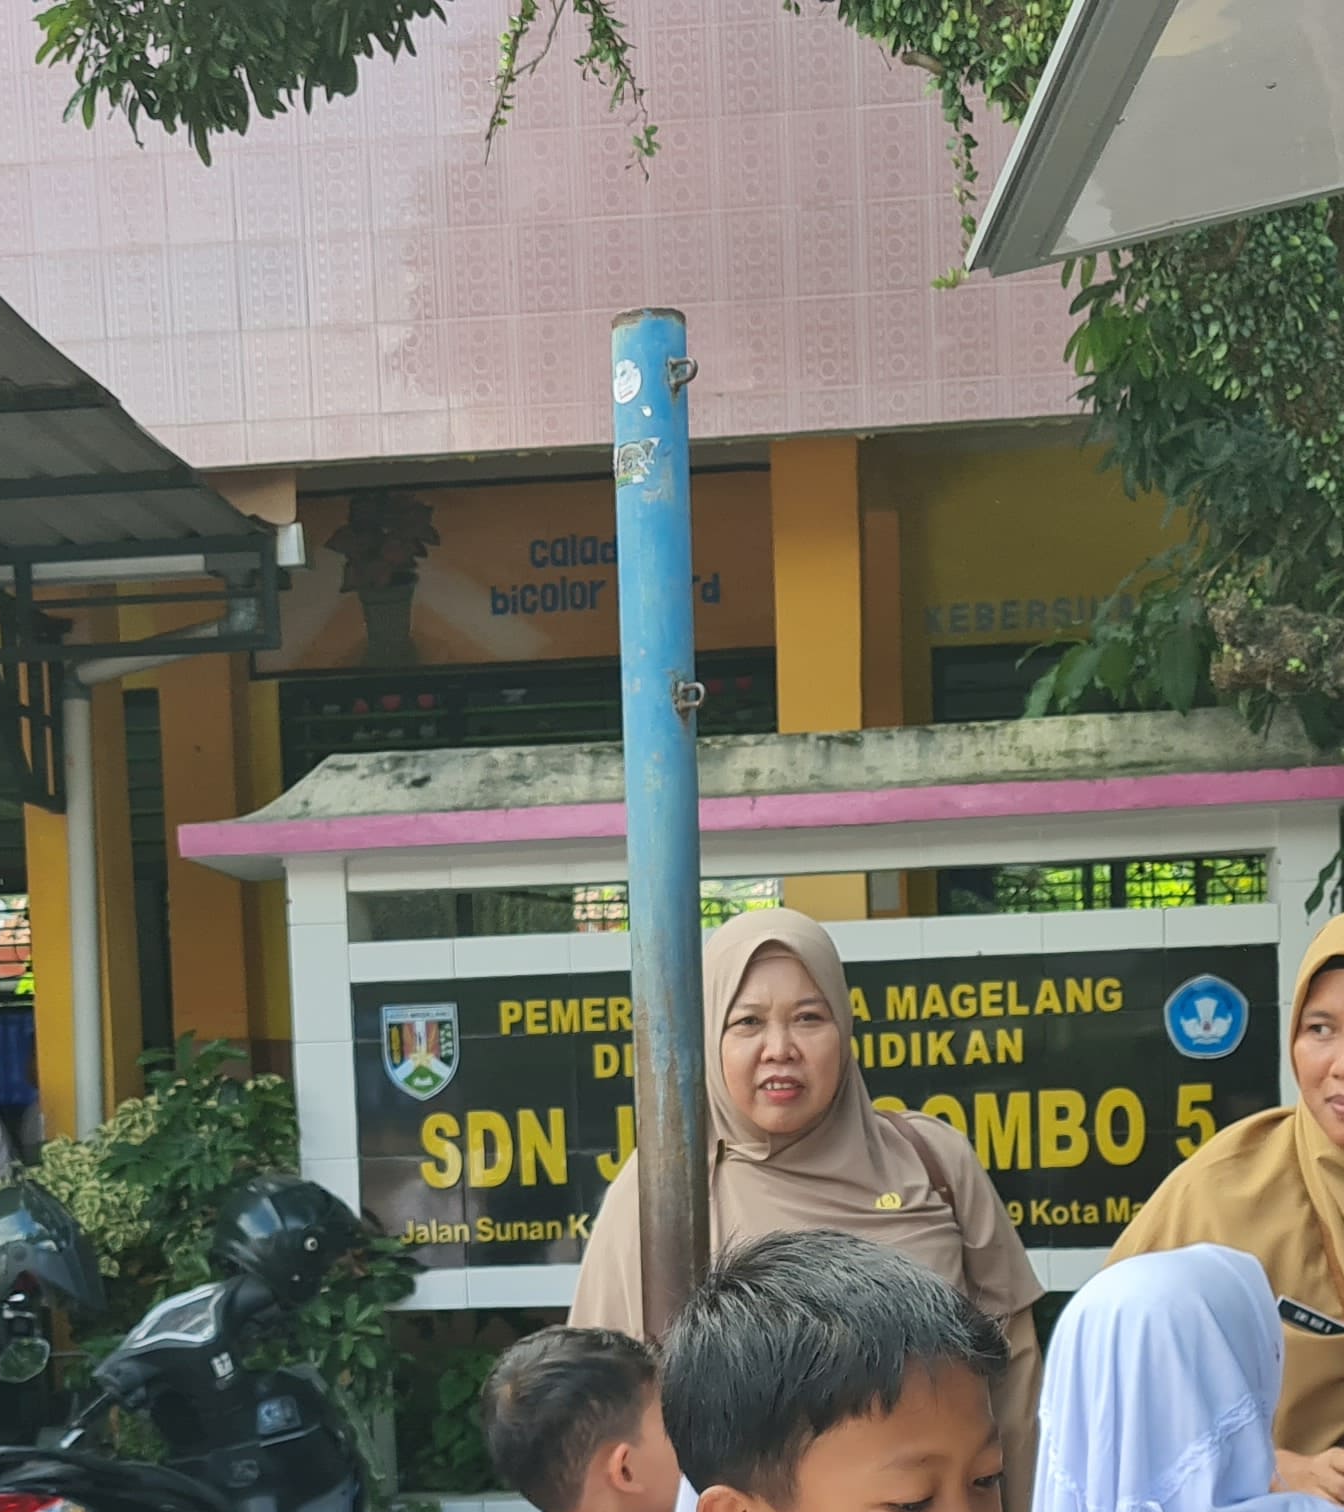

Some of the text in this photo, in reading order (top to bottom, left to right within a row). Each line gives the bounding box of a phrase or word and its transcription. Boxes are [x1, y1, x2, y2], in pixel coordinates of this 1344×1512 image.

[530, 534, 619, 568] calad
[490, 576, 606, 615] bicolor
[499, 996, 632, 1034] PEMER
[886, 977, 1123, 1021] MAGELANG
[420, 1107, 568, 1188] SDN
[1175, 1083, 1216, 1159] 5
[400, 1219, 470, 1244] Jalan
[475, 1217, 563, 1242] Sunan
[1030, 1199, 1100, 1226] Kota
